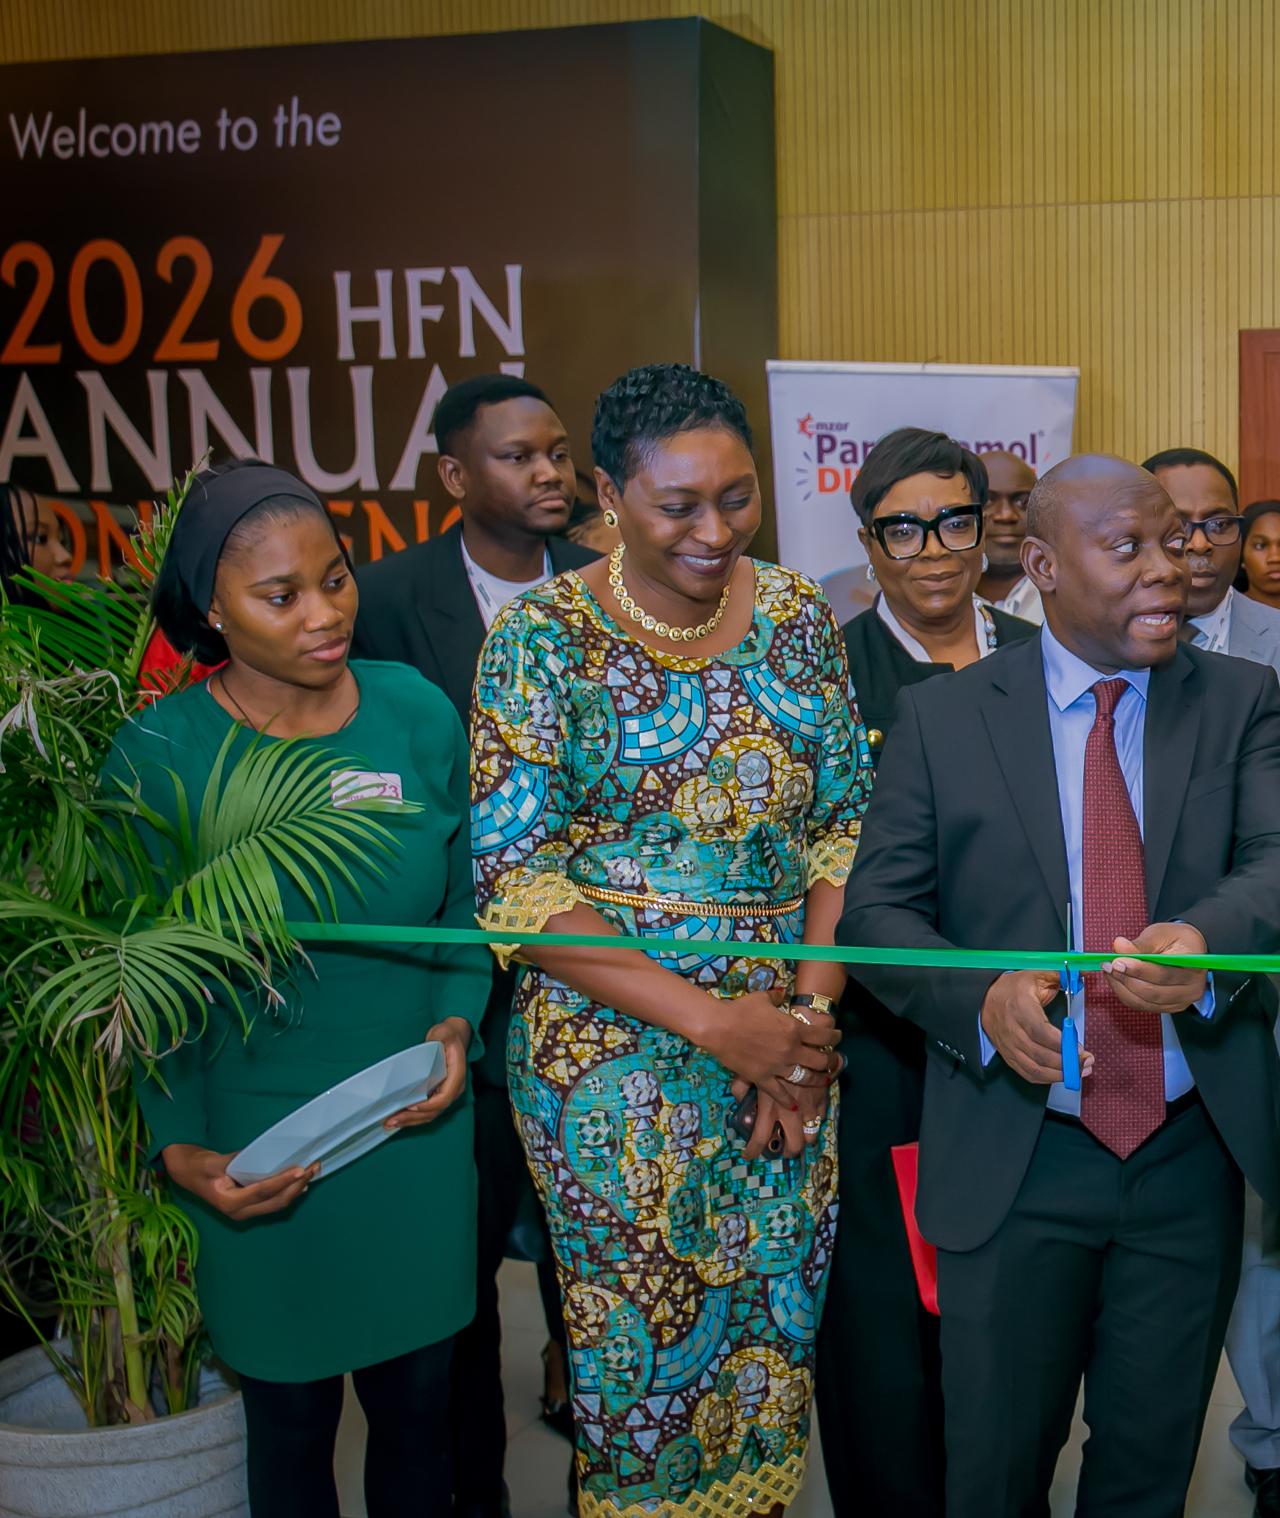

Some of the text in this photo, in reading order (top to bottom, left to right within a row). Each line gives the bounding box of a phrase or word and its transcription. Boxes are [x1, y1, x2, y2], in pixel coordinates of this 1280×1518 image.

[9, 95, 342, 160] Welcome to the
[0, 233, 526, 365] 2026 HFN
[0, 362, 525, 493] ANNUA
